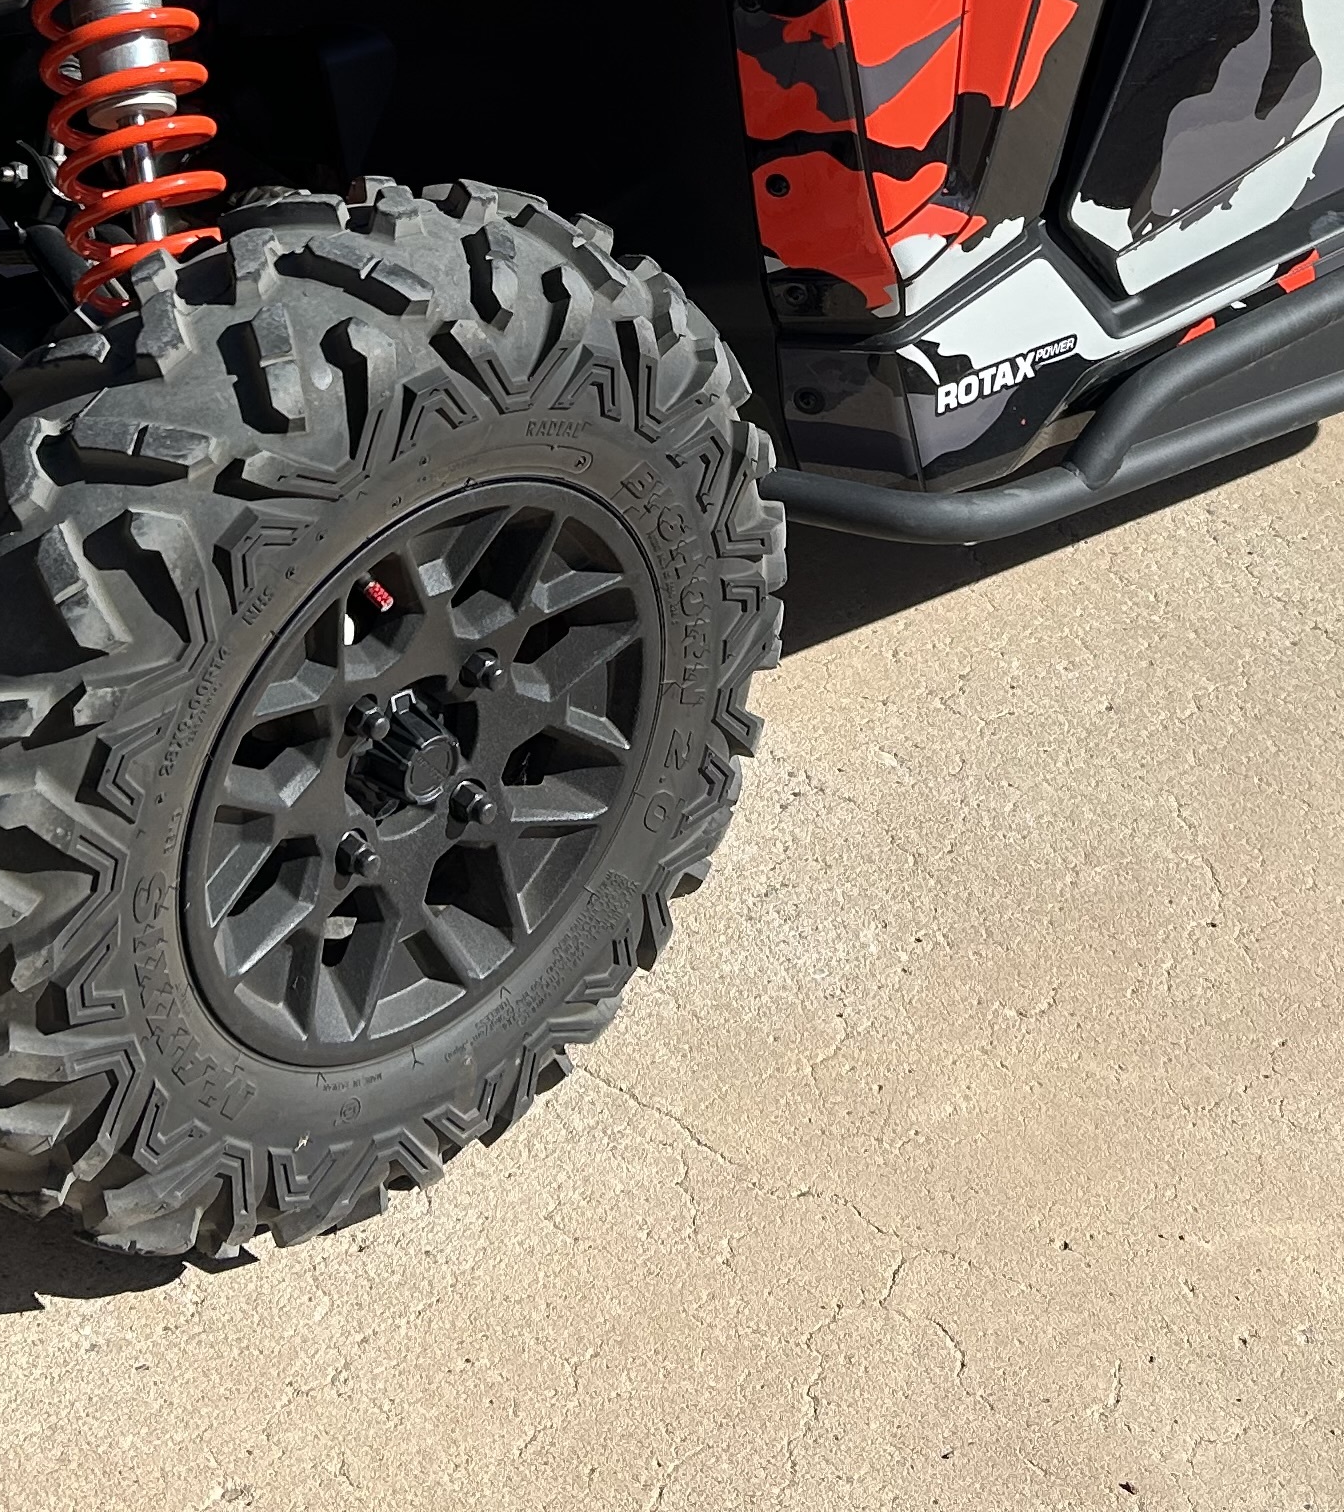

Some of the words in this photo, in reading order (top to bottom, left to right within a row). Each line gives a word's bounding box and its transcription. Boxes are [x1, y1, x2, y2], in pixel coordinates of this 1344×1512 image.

[936, 352, 1036, 414] ROTAX
[1035, 337, 1075, 362] POWER
[525, 419, 592, 439] RADIAL
[241, 586, 275, 626] NHS
[643, 728, 693, 833] 2.0
